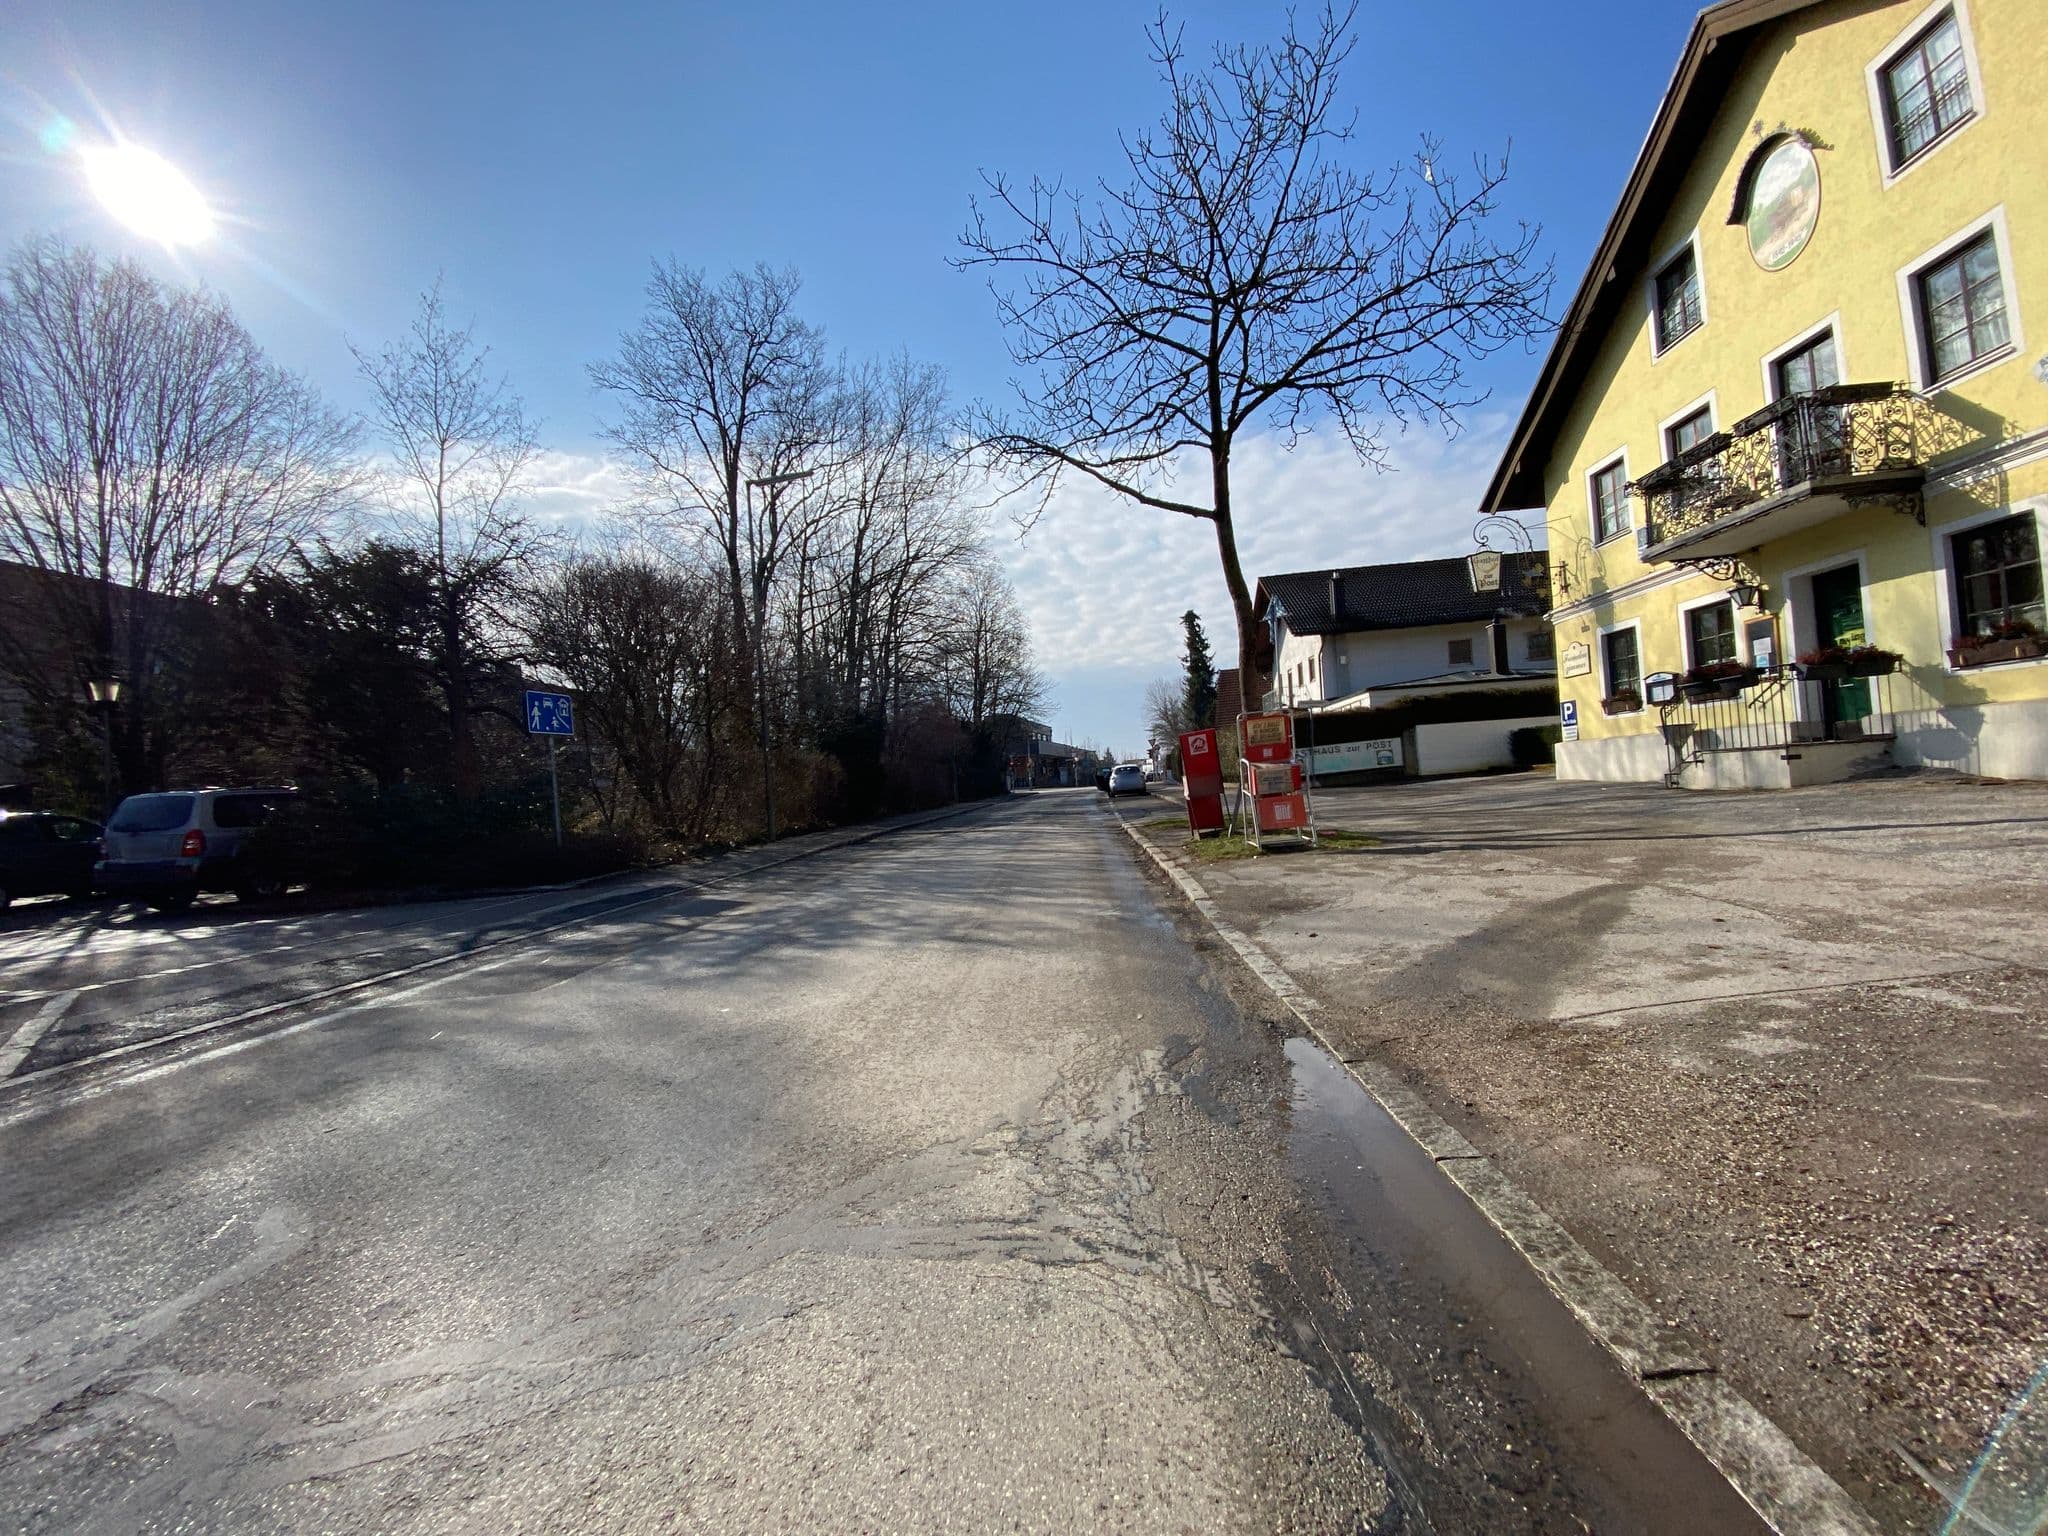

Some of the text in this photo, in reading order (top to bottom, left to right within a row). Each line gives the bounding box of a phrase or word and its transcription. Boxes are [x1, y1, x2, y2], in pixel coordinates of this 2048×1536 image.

[1564, 702, 1573, 720] P
[1346, 745, 1360, 753] zur
[1366, 740, 1392, 750] POST
